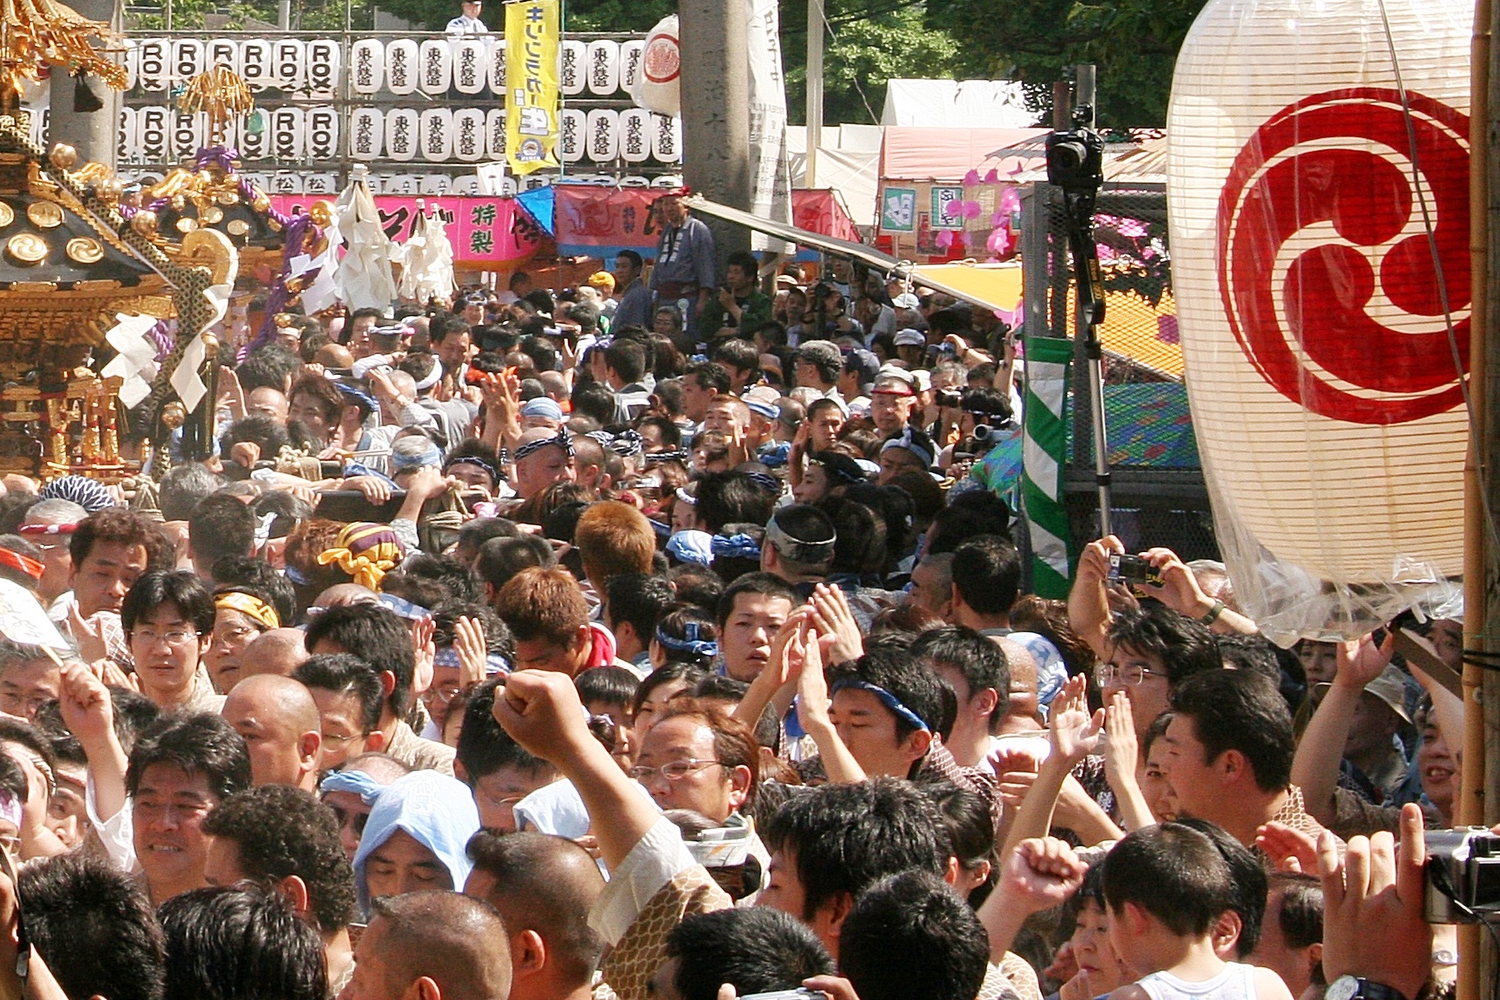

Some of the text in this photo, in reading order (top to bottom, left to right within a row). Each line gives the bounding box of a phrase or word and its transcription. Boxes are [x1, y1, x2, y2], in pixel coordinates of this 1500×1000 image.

[142, 43, 163, 89] ROX
[177, 43, 196, 81] RO
[311, 44, 332, 89] ROX
[143, 111, 164, 158] ROX
[174, 113, 196, 158] ROX
[276, 112, 295, 158] ROX
[311, 112, 332, 159] ROX
[470, 203, 496, 254] 特製
